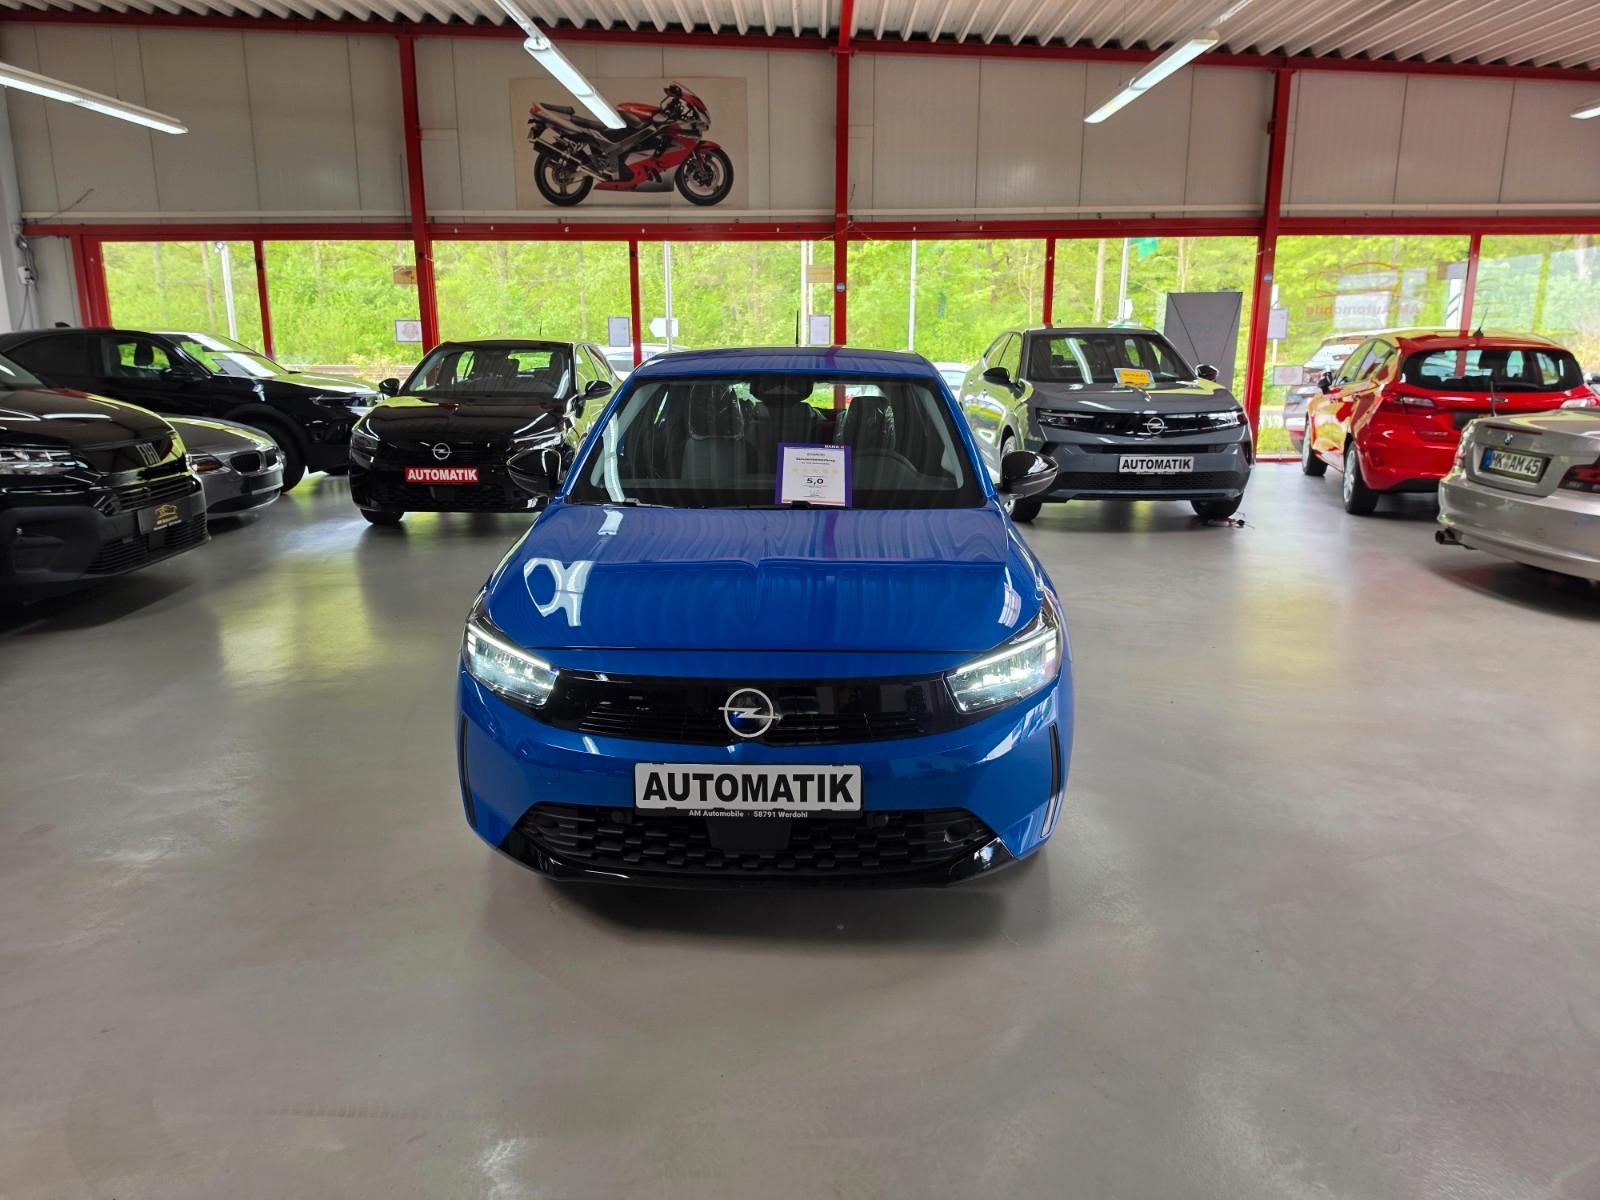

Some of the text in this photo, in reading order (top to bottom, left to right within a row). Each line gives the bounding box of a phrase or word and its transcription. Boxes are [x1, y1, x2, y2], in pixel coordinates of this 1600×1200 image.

[1122, 459, 1191, 470] AUTOMATIK
[1508, 455, 1526, 472] AM
[1524, 458, 1541, 474] 45
[407, 469, 478, 481] AUTOMATIK
[806, 477, 824, 485] 5,0
[642, 772, 854, 803] AUTOMATIK
[688, 809, 702, 817] AM
[702, 809, 744, 818] Automobile
[777, 811, 808, 819] Werdohl
